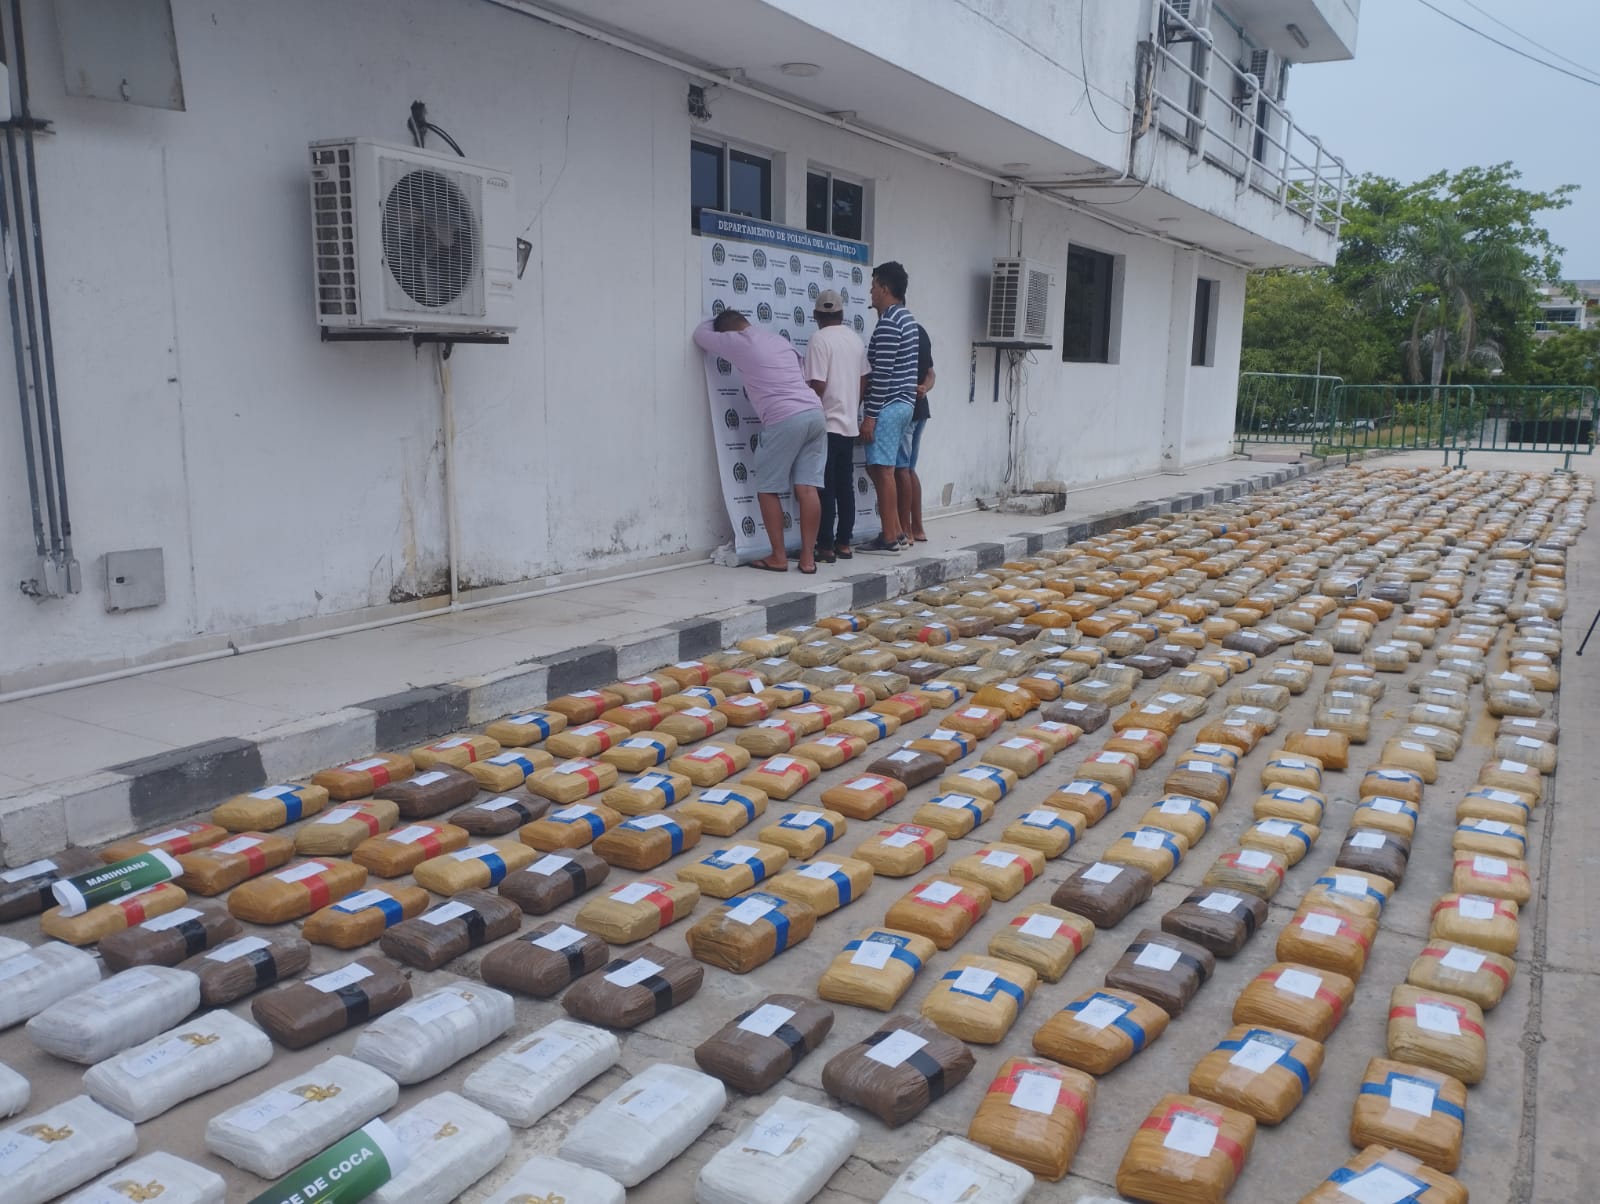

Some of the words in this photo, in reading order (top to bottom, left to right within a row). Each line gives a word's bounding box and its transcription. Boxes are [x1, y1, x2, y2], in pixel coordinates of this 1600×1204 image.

[718, 220, 775, 239] DEPARTAMENTO
[776, 230, 786, 241] DE
[786, 233, 812, 246] POLICÍA
[812, 238, 825, 249] DEL
[86, 861, 149, 887] MARIHUANA
[303, 1176, 329, 1199] DE
[328, 1147, 374, 1181] COCA
